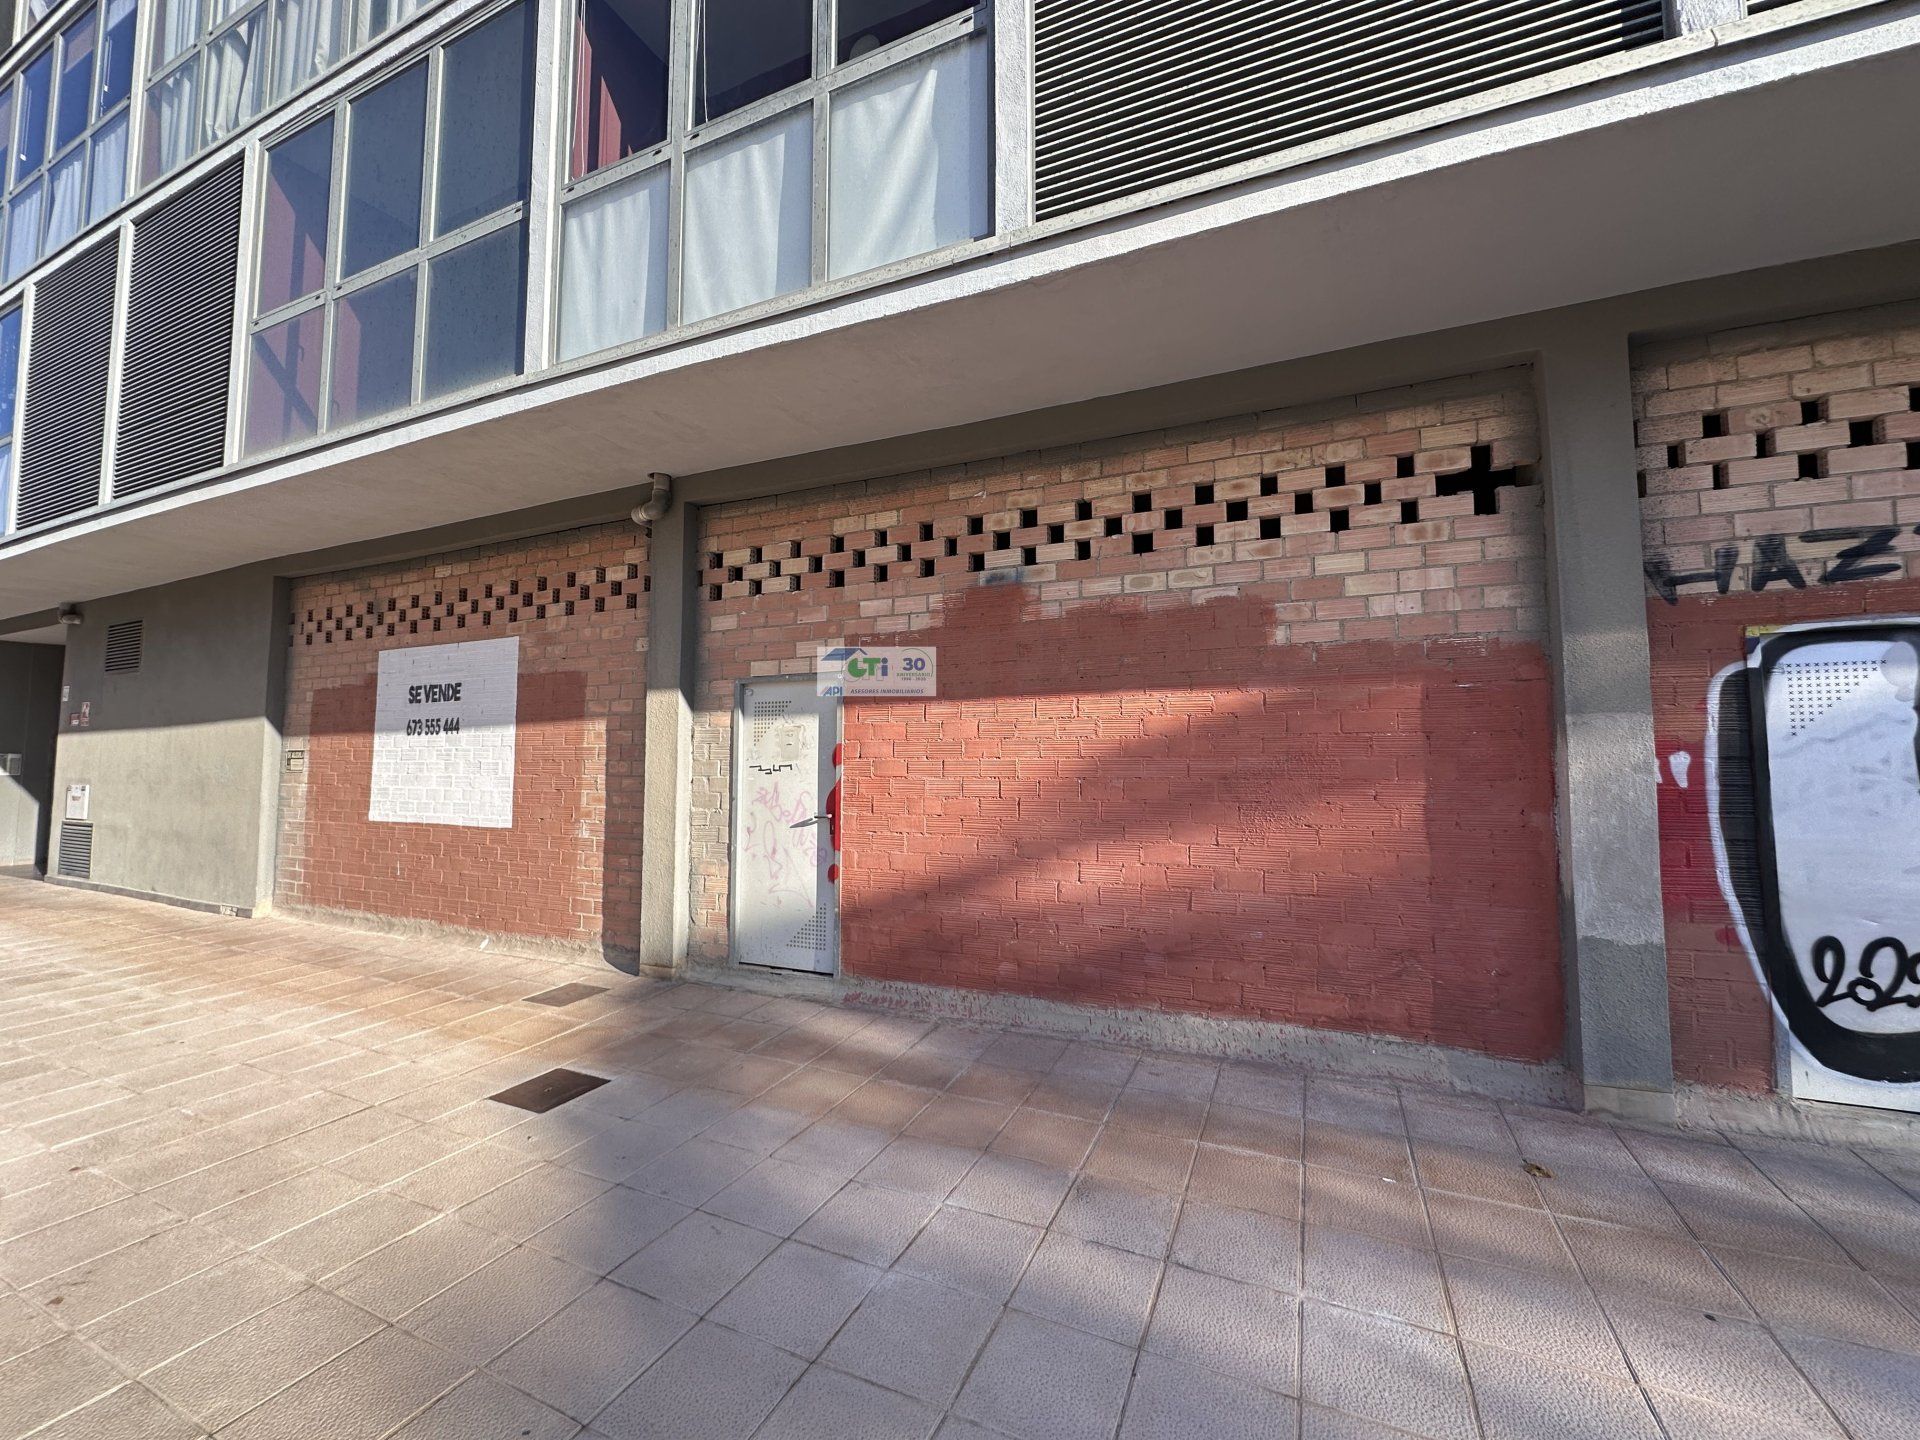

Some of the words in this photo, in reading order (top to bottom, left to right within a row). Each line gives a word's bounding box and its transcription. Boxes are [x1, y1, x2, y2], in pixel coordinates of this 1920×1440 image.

[408, 685, 423, 704] SE
[423, 683, 462, 703] VENDE
[406, 718, 423, 736] 673
[424, 718, 441, 736] 555
[442, 717, 461, 735] 444
